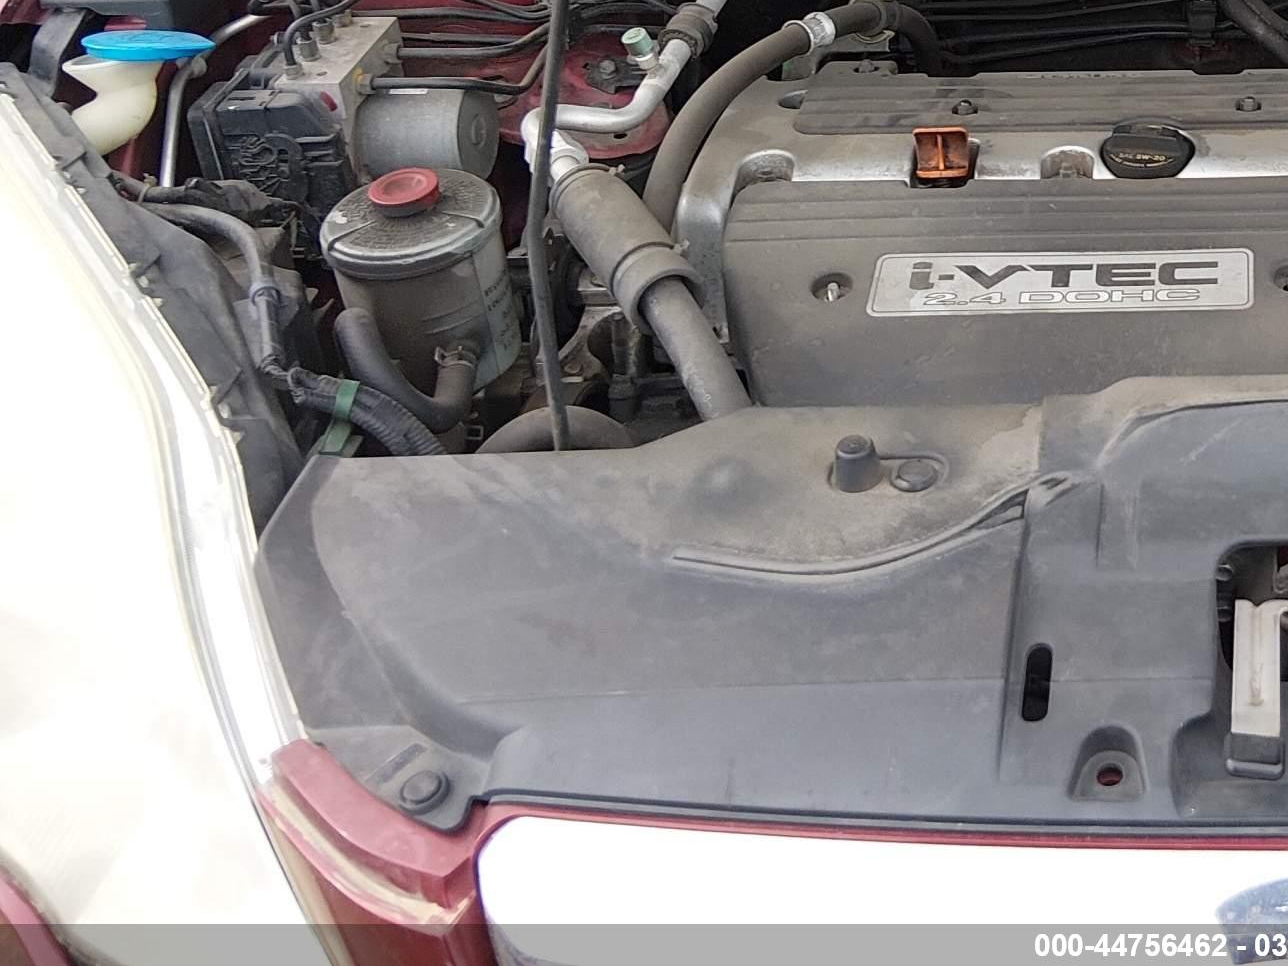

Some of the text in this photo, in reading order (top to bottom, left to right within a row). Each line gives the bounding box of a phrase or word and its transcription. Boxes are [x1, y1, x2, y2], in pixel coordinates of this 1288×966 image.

[909, 260, 1218, 291] i-VTEC
[924, 288, 1200, 306] 2.4 DOHC
